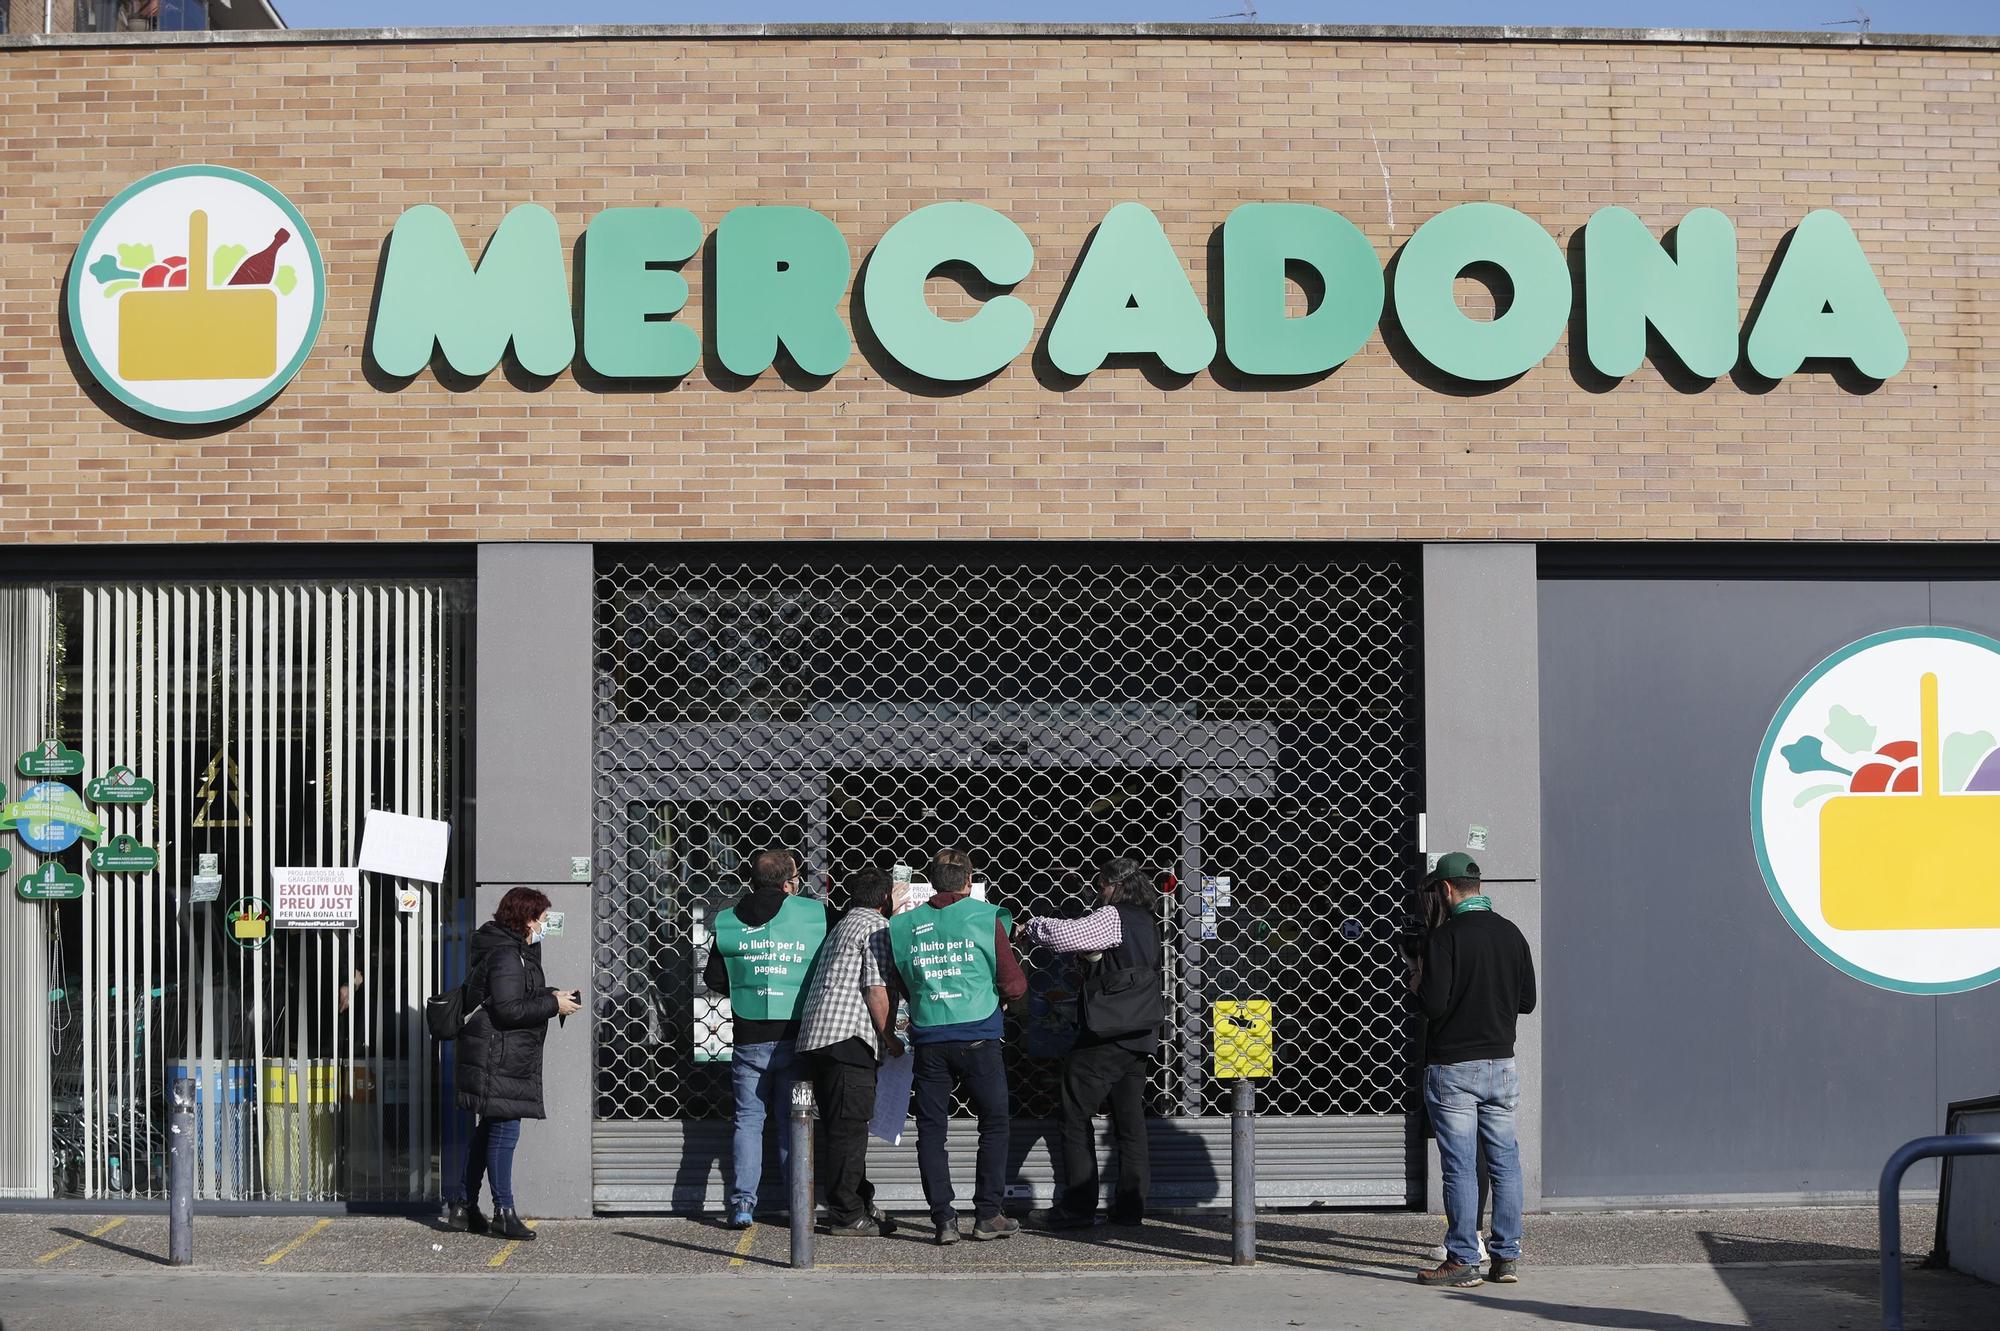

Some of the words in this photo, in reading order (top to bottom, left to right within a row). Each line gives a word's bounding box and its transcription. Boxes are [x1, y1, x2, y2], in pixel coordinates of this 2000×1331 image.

[370, 201, 1909, 383] MERCADONA
[25, 757, 30, 770] 1
[94, 784, 100, 797] 2
[97, 853, 104, 866] 3
[24, 880, 32, 893] 4
[280, 885, 328, 895] EXIGIM
[334, 885, 352, 895] UN
[280, 898, 315, 909] PREU
[320, 898, 352, 909] JUST
[739, 942, 748, 950] Jo
[751, 940, 775, 949] lluito
[777, 942, 794, 951] per
[796, 941, 805, 950] la
[910, 945, 918, 953] Jo
[920, 942, 944, 952] lluito
[947, 941, 962, 951] per
[966, 939, 974, 948] la
[793, 954, 802, 963] la
[913, 955, 948, 967] dignitat
[950, 953, 962, 962] de
[965, 952, 974, 961] la
[754, 965, 787, 975] pagesia
[925, 966, 961, 980] pagesia
